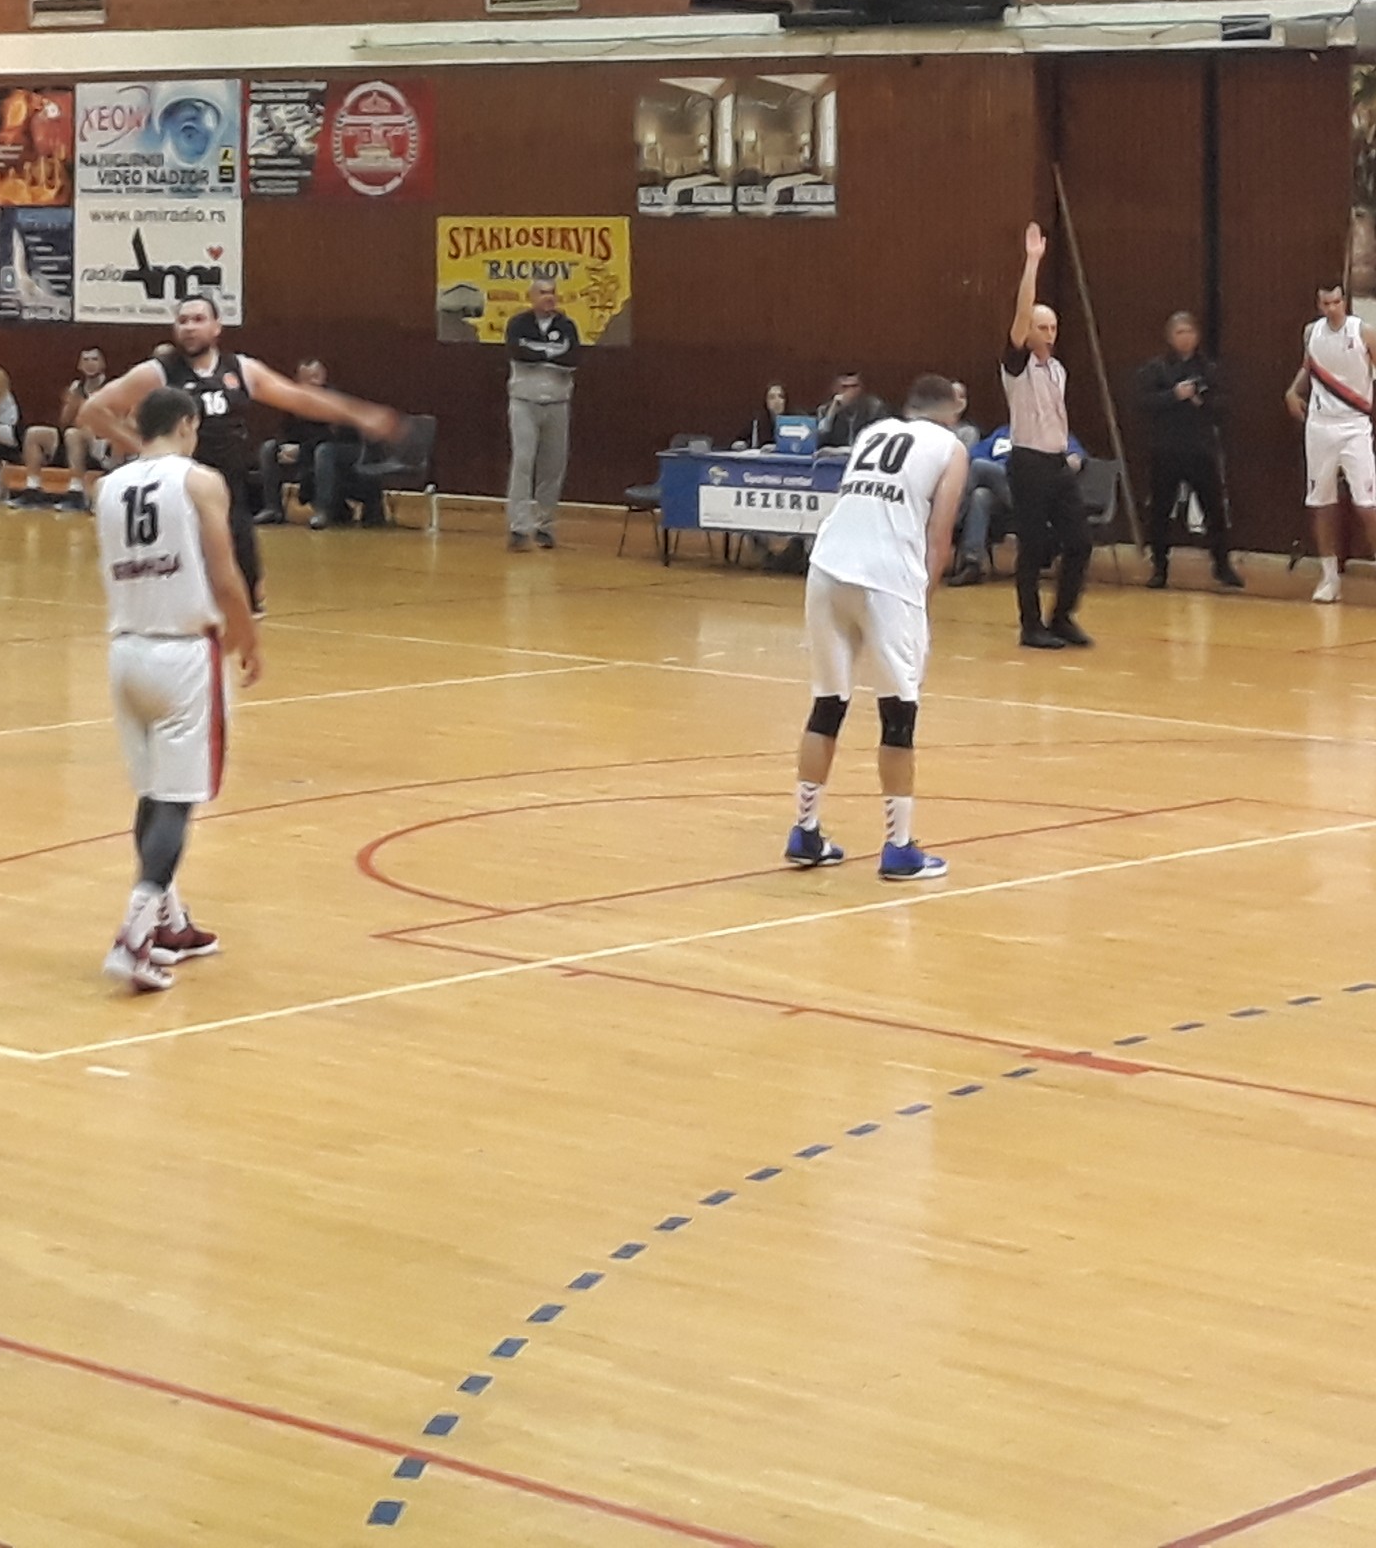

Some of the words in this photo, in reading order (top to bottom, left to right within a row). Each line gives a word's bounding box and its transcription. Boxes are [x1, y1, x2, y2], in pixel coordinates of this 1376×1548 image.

[98, 169, 142, 185] VIDEO
[147, 169, 209, 185] NADZOR
[89, 207, 226, 222] www.amiradio.rs
[447, 226, 612, 261] STAKLOSERVIS
[201, 391, 228, 415] 16
[853, 432, 915, 475] 20
[122, 480, 160, 547] 15
